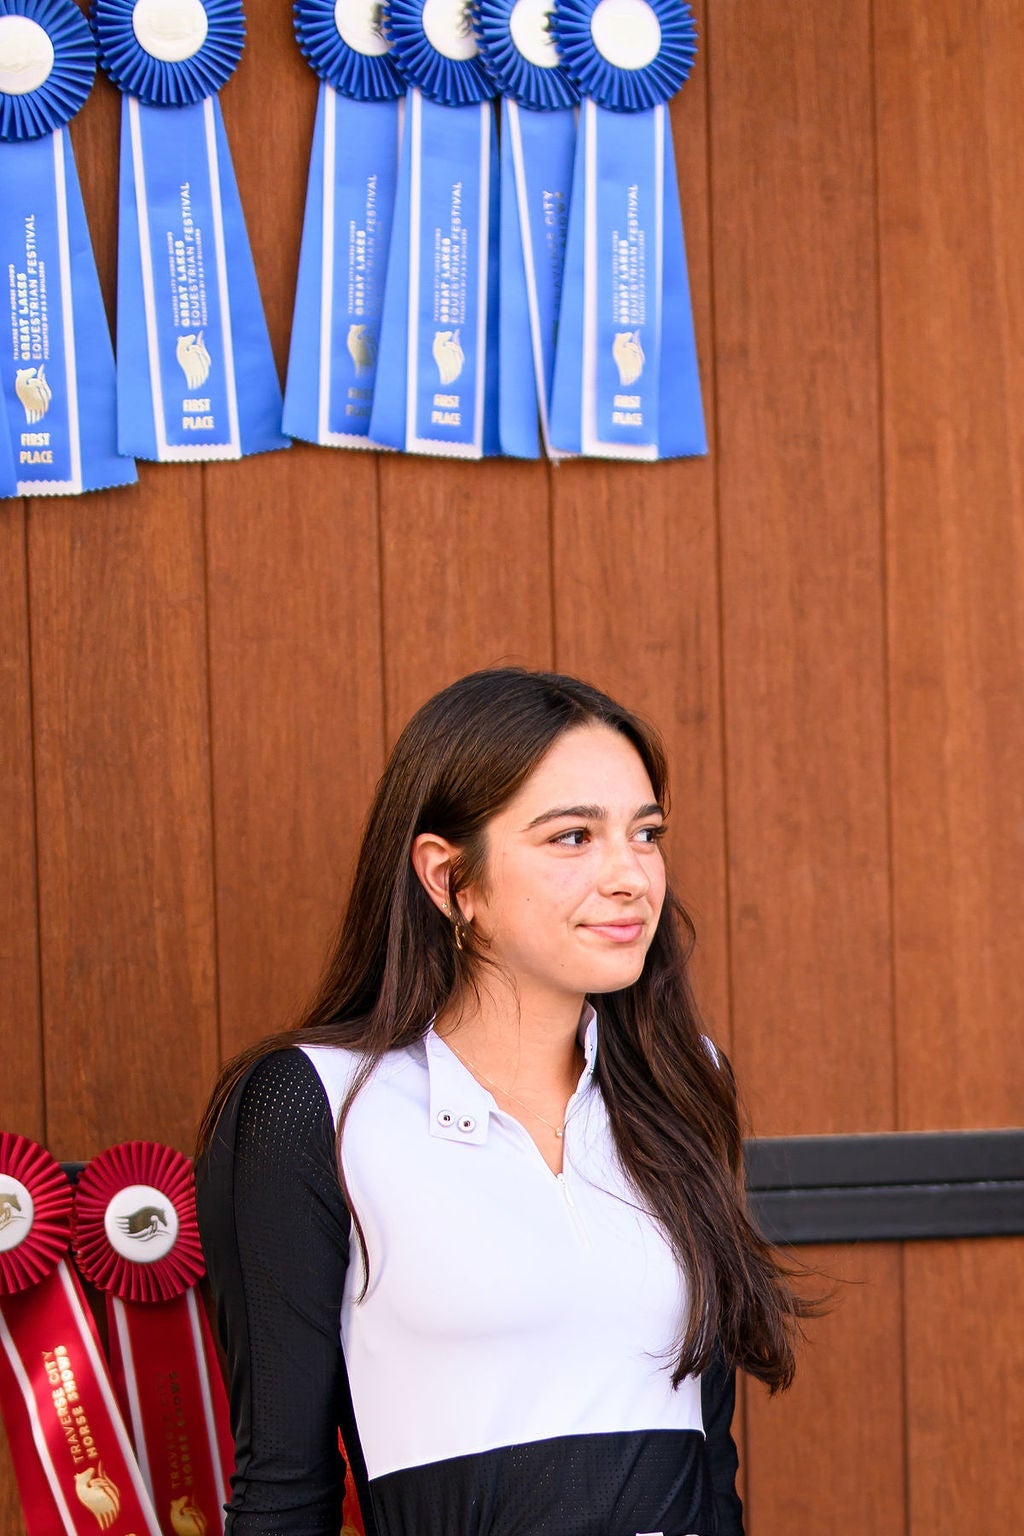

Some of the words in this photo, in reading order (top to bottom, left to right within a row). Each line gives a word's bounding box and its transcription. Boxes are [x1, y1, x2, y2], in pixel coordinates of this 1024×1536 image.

[180, 182, 194, 241] FESTIVAL
[366, 174, 377, 232] FESTIVAL
[451, 182, 462, 240] FESTIVAL
[542, 190, 554, 226] CITY
[628, 184, 638, 242] FESTIVAL
[25, 214, 37, 274] FESTIVAL
[175, 240, 187, 281] LAKES
[356, 230, 366, 271] LAKES
[441, 237, 450, 279] LAKES
[618, 240, 629, 280] LAKES
[17, 273, 29, 314] LAKES
[186, 246, 200, 326] EQUESTRIAN
[355, 274, 364, 315] GREAT
[440, 282, 450, 323] GREAT
[450, 244, 460, 324] EQUESTRIAN
[619, 283, 630, 324] GREAT
[630, 246, 638, 325] EQUESTRIAN
[29, 279, 42, 360] EQUESTRIAN
[178, 285, 190, 327] GREAT
[19, 318, 31, 360] GREAT
[183, 399, 211, 412] FIRST
[431, 411, 461, 426] PLACE
[433, 394, 459, 408] FIRST
[612, 412, 642, 425] PLACE
[21, 433, 50, 446] FIRST
[183, 416, 215, 430] PLACE
[20, 450, 53, 464] PLACE
[42, 1351, 60, 1385] CITY
[54, 1345, 79, 1402] SHOWS
[52, 1387, 84, 1464] TRAVERSE
[72, 1406, 98, 1458] HORSE
